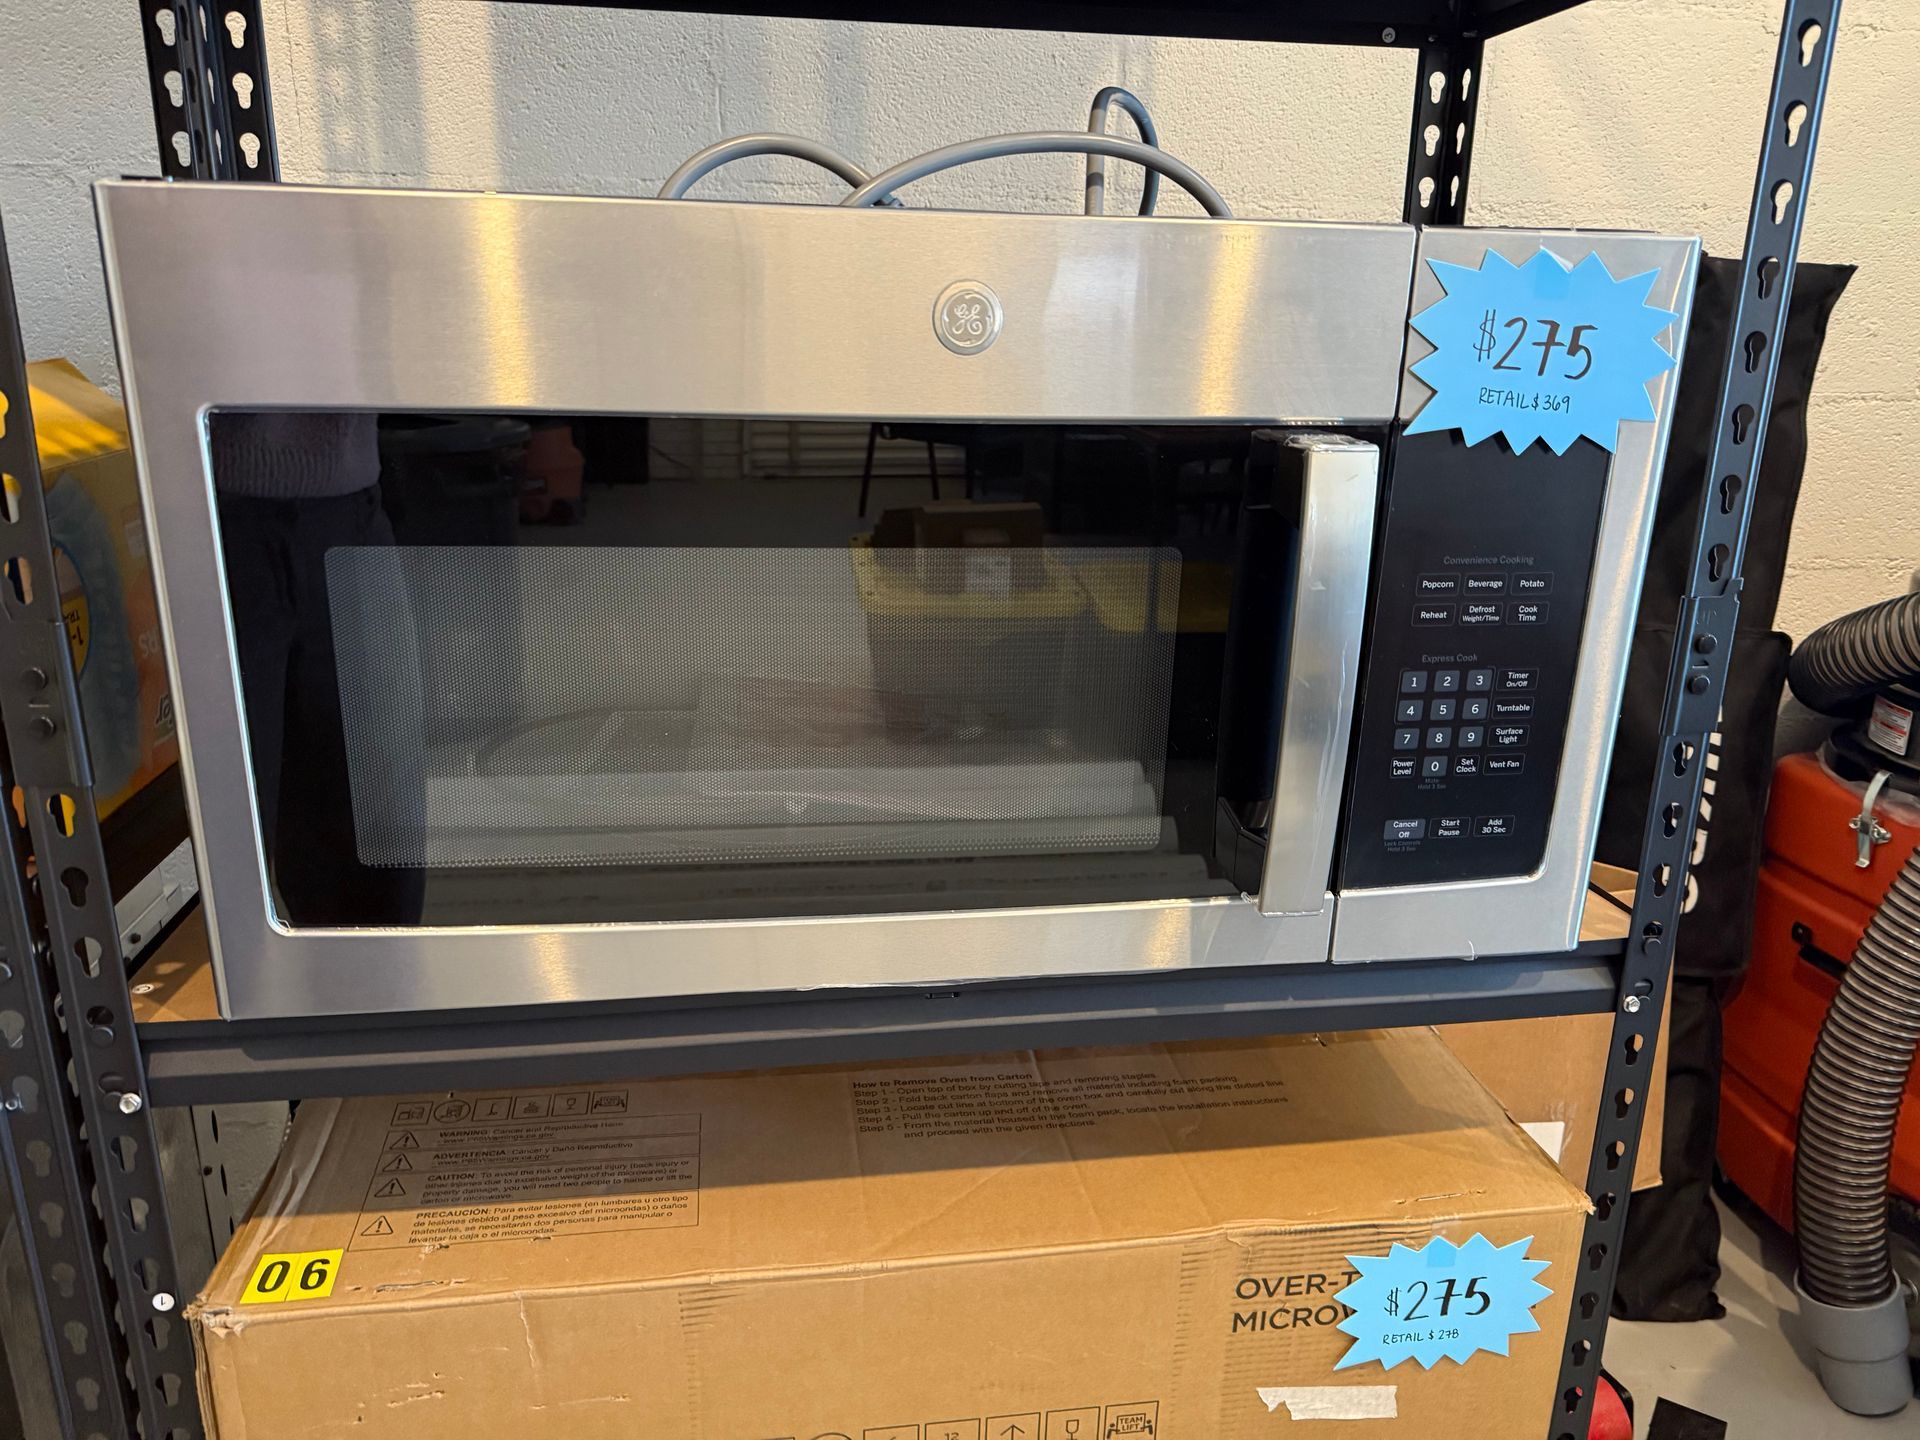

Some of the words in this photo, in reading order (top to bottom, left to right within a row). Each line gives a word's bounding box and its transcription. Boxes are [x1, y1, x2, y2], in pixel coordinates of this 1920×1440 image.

[1473, 309, 1598, 380] $275
[1443, 555, 1498, 565] Convenience
[1500, 555, 1534, 565] Cooking
[1422, 580, 1454, 590] Popcorn
[1468, 579, 1503, 589] Beverage
[1520, 579, 1545, 588] Potato
[1469, 605, 1496, 613] Defrost
[1518, 605, 1538, 613] Cook
[1420, 611, 1447, 619] Reheat
[1462, 614, 1500, 623] Weight/Time
[1518, 614, 1537, 622] Time
[1422, 653, 1454, 664] Express
[1456, 653, 1478, 662] Cook
[1508, 671, 1529, 679] Timer
[1411, 677, 1417, 687] 1
[1443, 676, 1451, 687] 2
[1475, 675, 1484, 686] 3
[1506, 680, 1528, 688] On/Off
[1406, 705, 1414, 716] 4
[1439, 705, 1447, 715] 5
[1471, 704, 1479, 714] 6
[1496, 704, 1531, 712] Turntable
[1404, 734, 1411, 744] 7
[1435, 733, 1443, 743] 8
[1467, 732, 1475, 742] 9
[1499, 735, 1517, 744] Light
[1392, 760, 1414, 768] Power
[1431, 761, 1439, 772] 0
[1461, 758, 1474, 766] Set
[1489, 761, 1506, 769] Vent
[1507, 760, 1520, 768] Fan
[1393, 767, 1412, 775] Level
[1456, 765, 1477, 773] Clock
[1487, 818, 1502, 826] Add
[1438, 829, 1460, 837] Pause
[1481, 826, 1492, 834] 30
[1493, 826, 1506, 834] Sec
[894, 1079, 937, 1087] Remove
[416, 1207, 491, 1219] PRECAUCIÓN:
[584, 1201, 599, 1209] (en
[601, 1198, 642, 1206] lumbares
[672, 1195, 688, 1203] tipo
[427, 1218, 466, 1226] lesiones
[468, 1215, 499, 1223] debido
[512, 1214, 535, 1222] peso
[537, 1211, 576, 1219] excesivo
[579, 1208, 593, 1216] del
[595, 1205, 650, 1215] microondas)
[661, 1203, 687, 1211] daños
[410, 1226, 461, 1235] materiales,
[478, 1221, 531, 1231] necesitarán
[553, 1217, 595, 1227] personas
[597, 1216, 617, 1224] para
[620, 1211, 664, 1221] manipular
[408, 1236, 445, 1244] levantar
[257, 1258, 330, 1293] 06
[1384, 1276, 1491, 1321] $275
[1232, 1304, 1358, 1333] MICRO
[1383, 1332, 1424, 1345] RETAIL
[1120, 1416, 1143, 1425] TEAM
